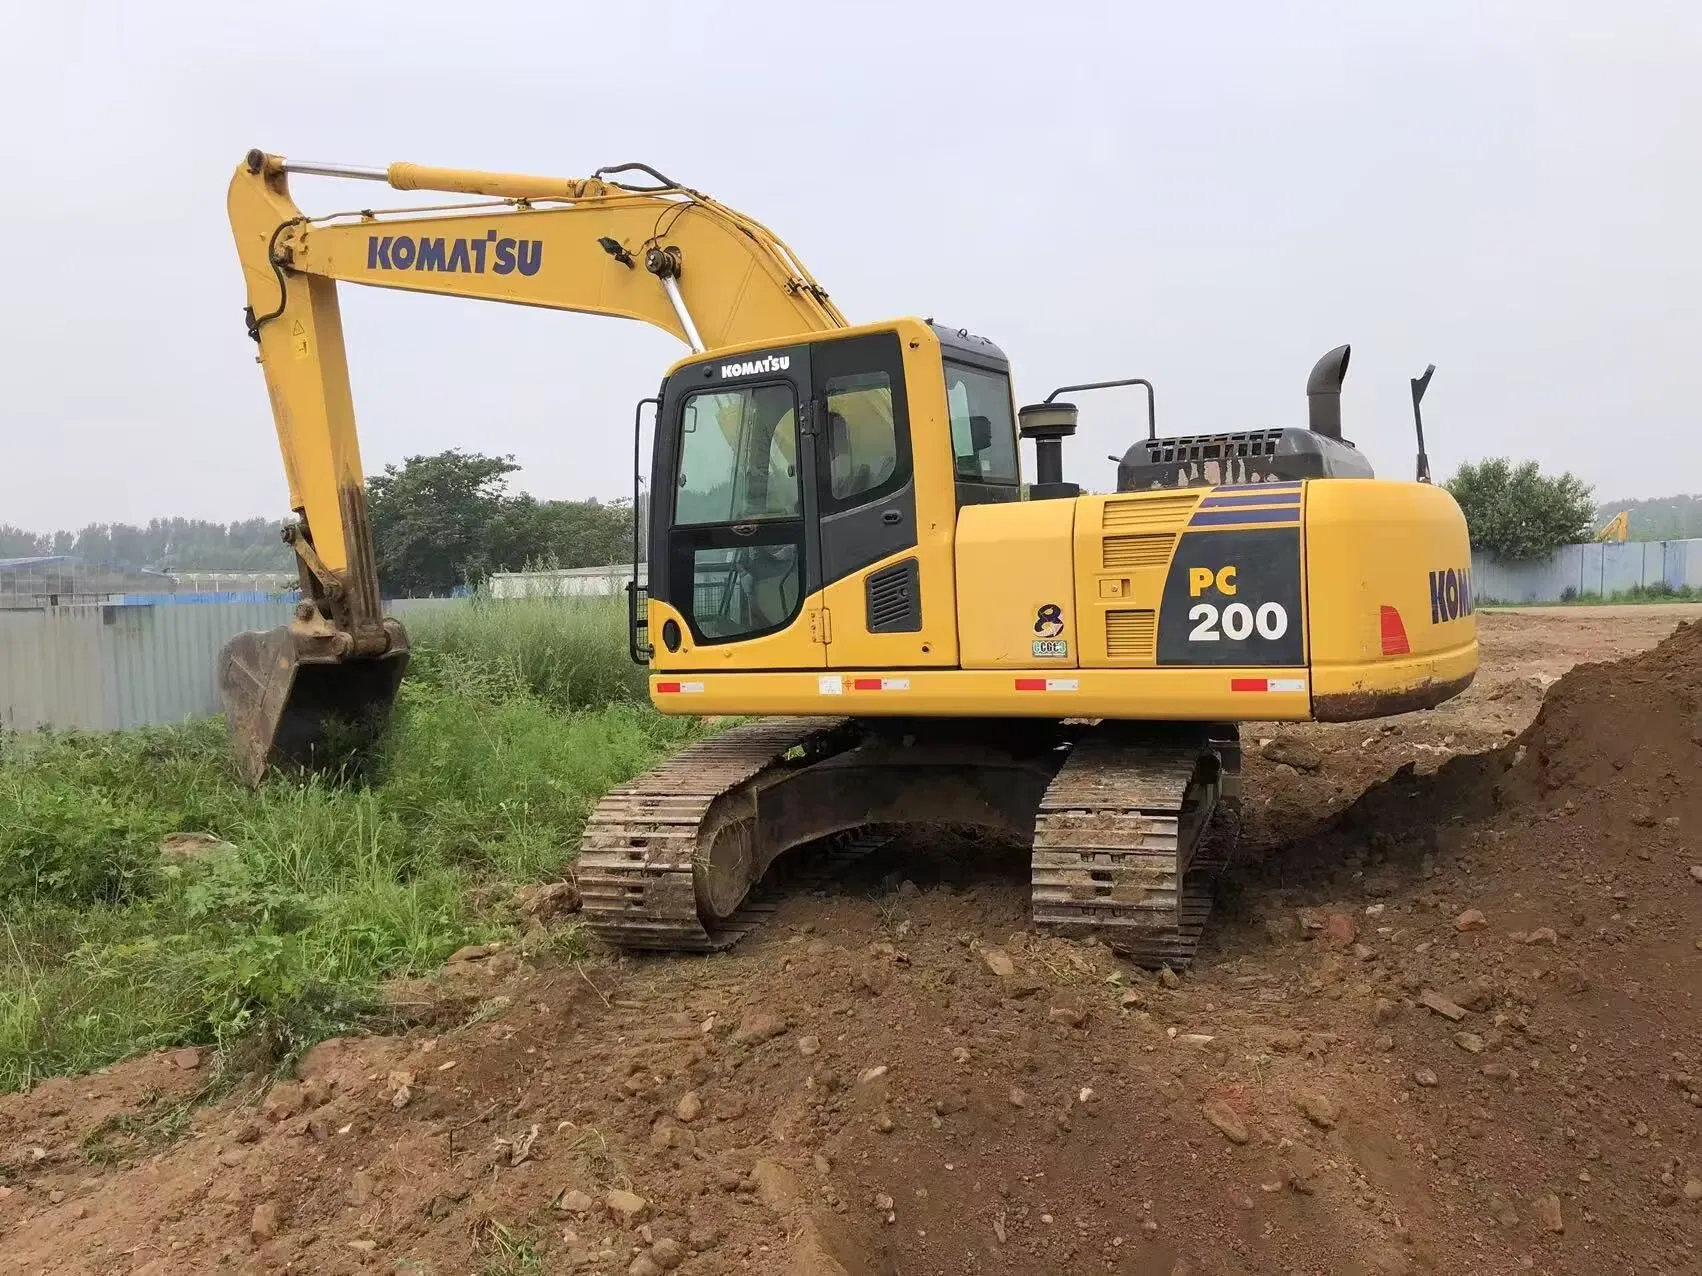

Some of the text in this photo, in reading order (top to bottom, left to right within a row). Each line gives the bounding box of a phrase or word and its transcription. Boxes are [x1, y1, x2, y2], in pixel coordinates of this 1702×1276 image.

[367, 229, 543, 276] KOMATSU
[721, 355, 790, 379] KOMATSU
[1189, 565, 1237, 597] PC
[1188, 601, 1288, 641] 200
